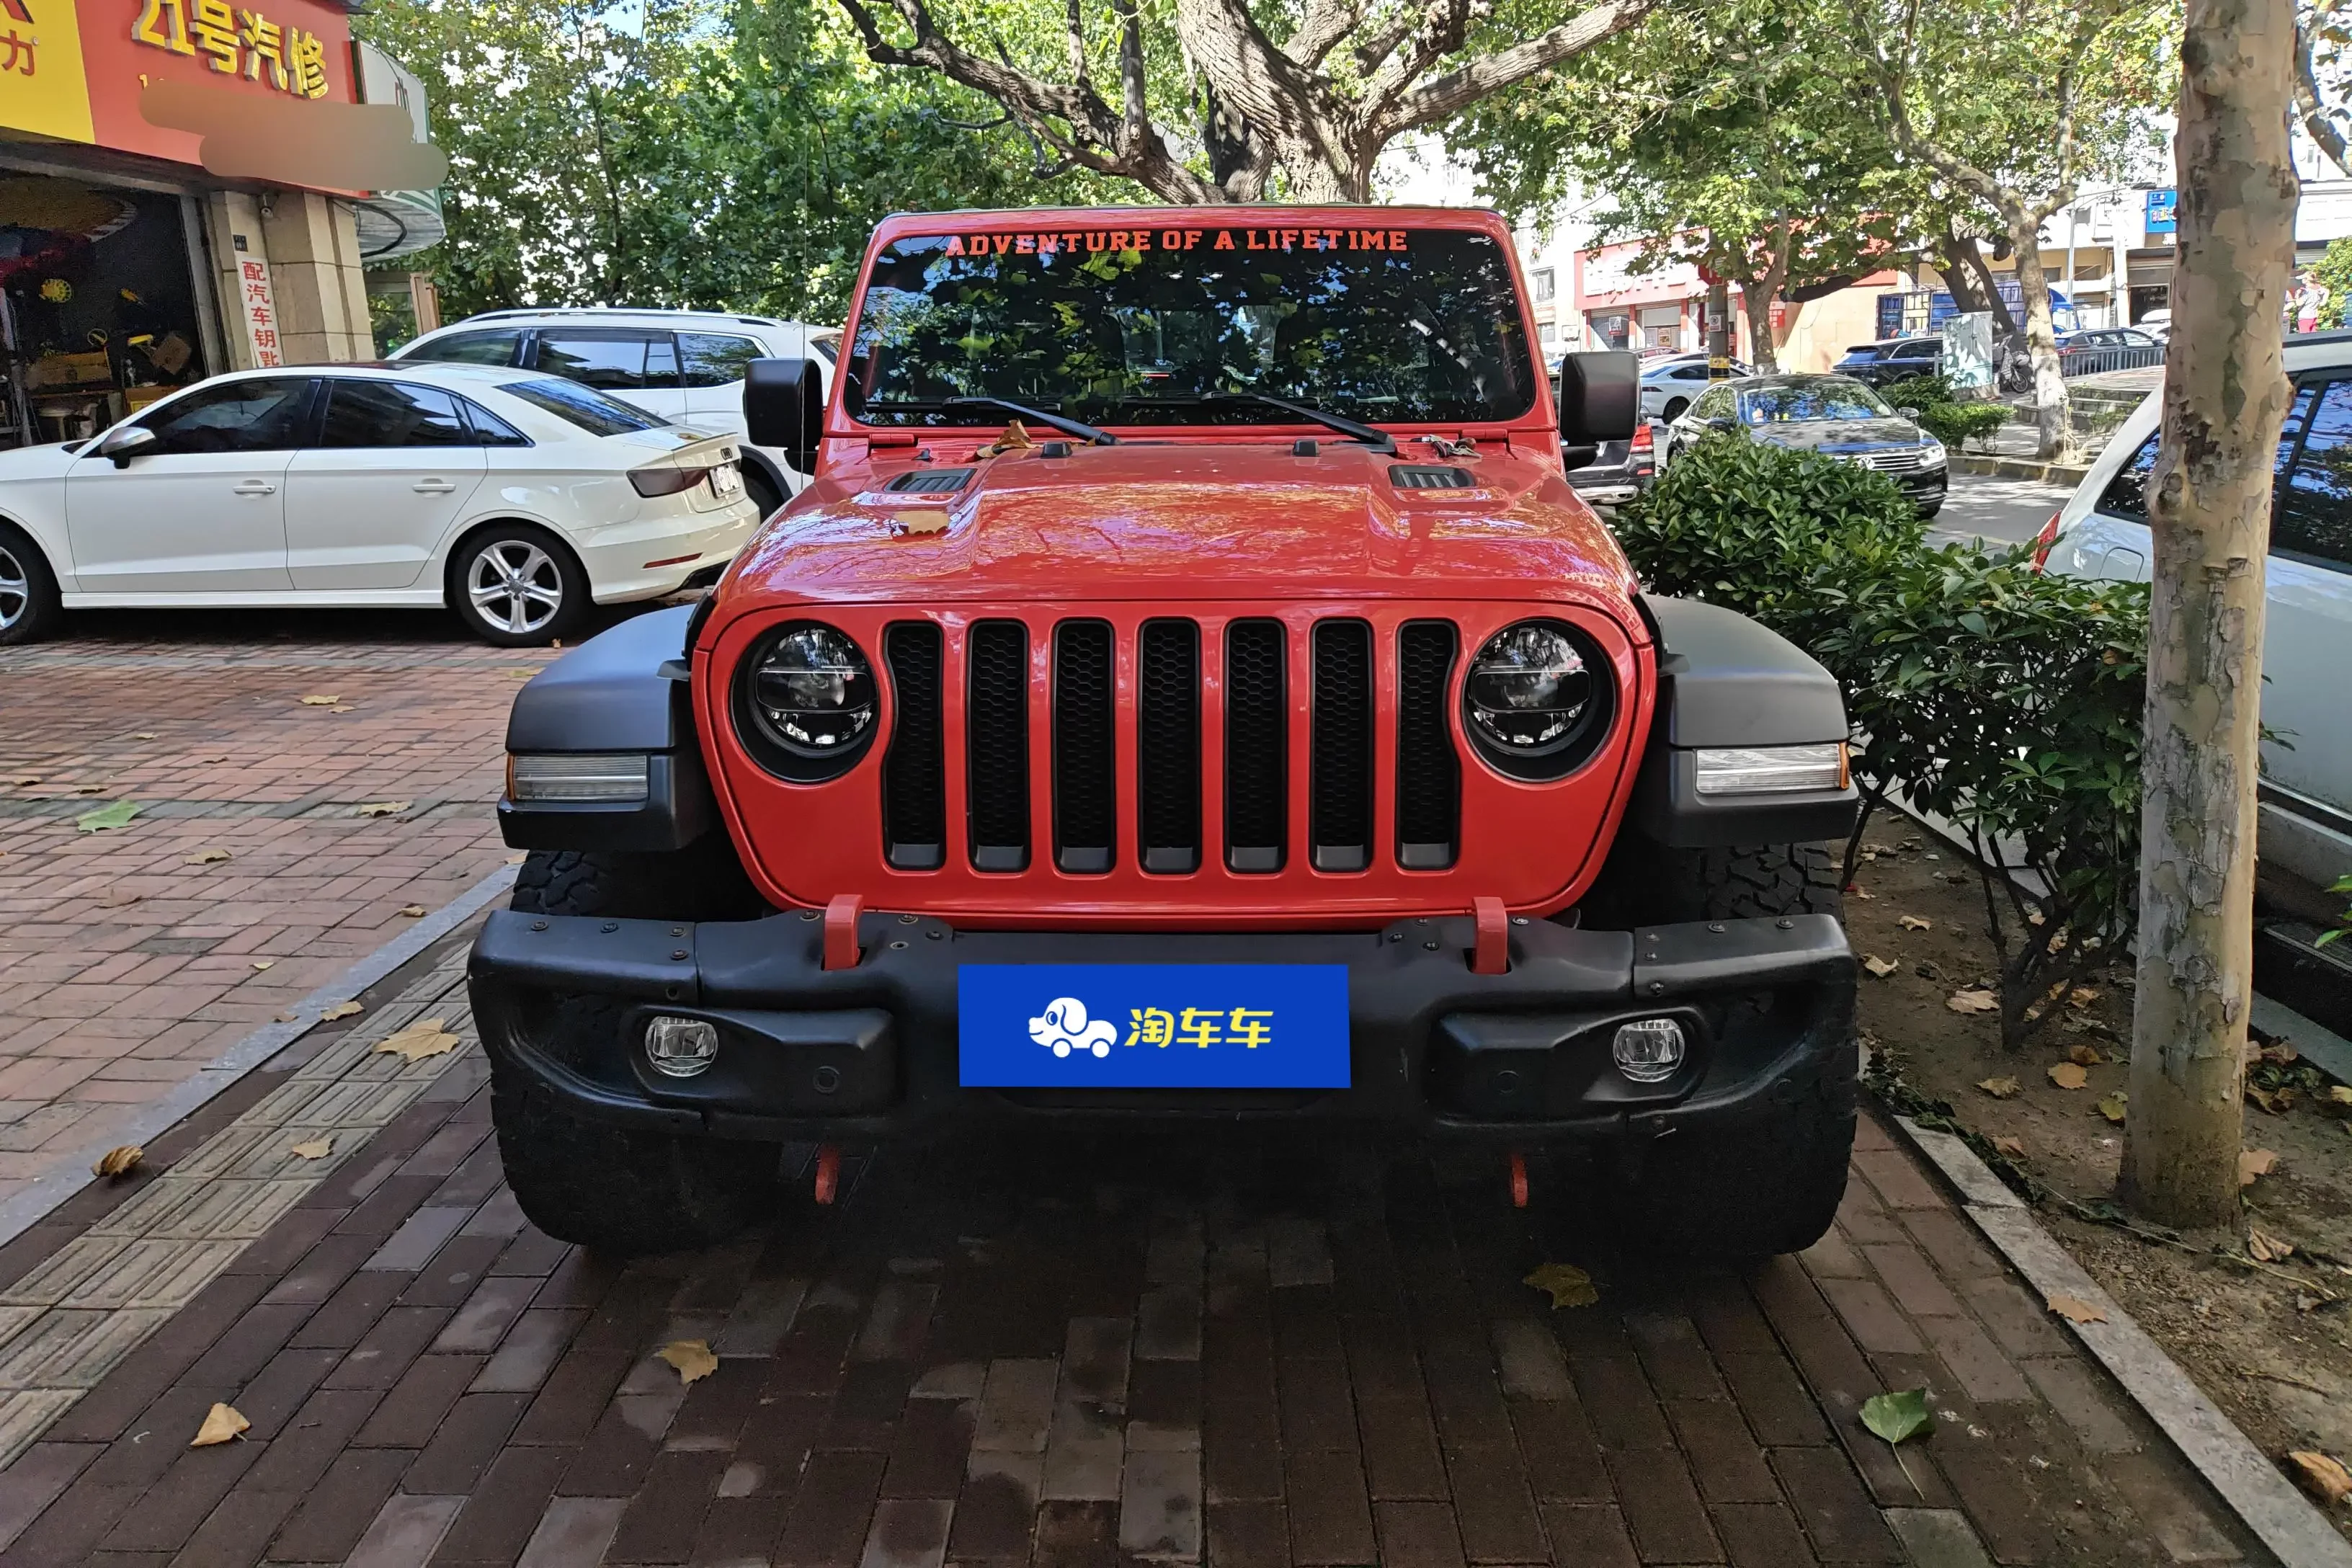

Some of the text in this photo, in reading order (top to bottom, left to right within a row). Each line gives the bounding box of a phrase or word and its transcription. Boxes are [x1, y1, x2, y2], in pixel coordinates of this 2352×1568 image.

[130, 0, 329, 99] 21号汽修
[945, 229, 1407, 256] ADVENTURE OF A LIFETIME
[242, 261, 280, 368] 配汽车钥匙
